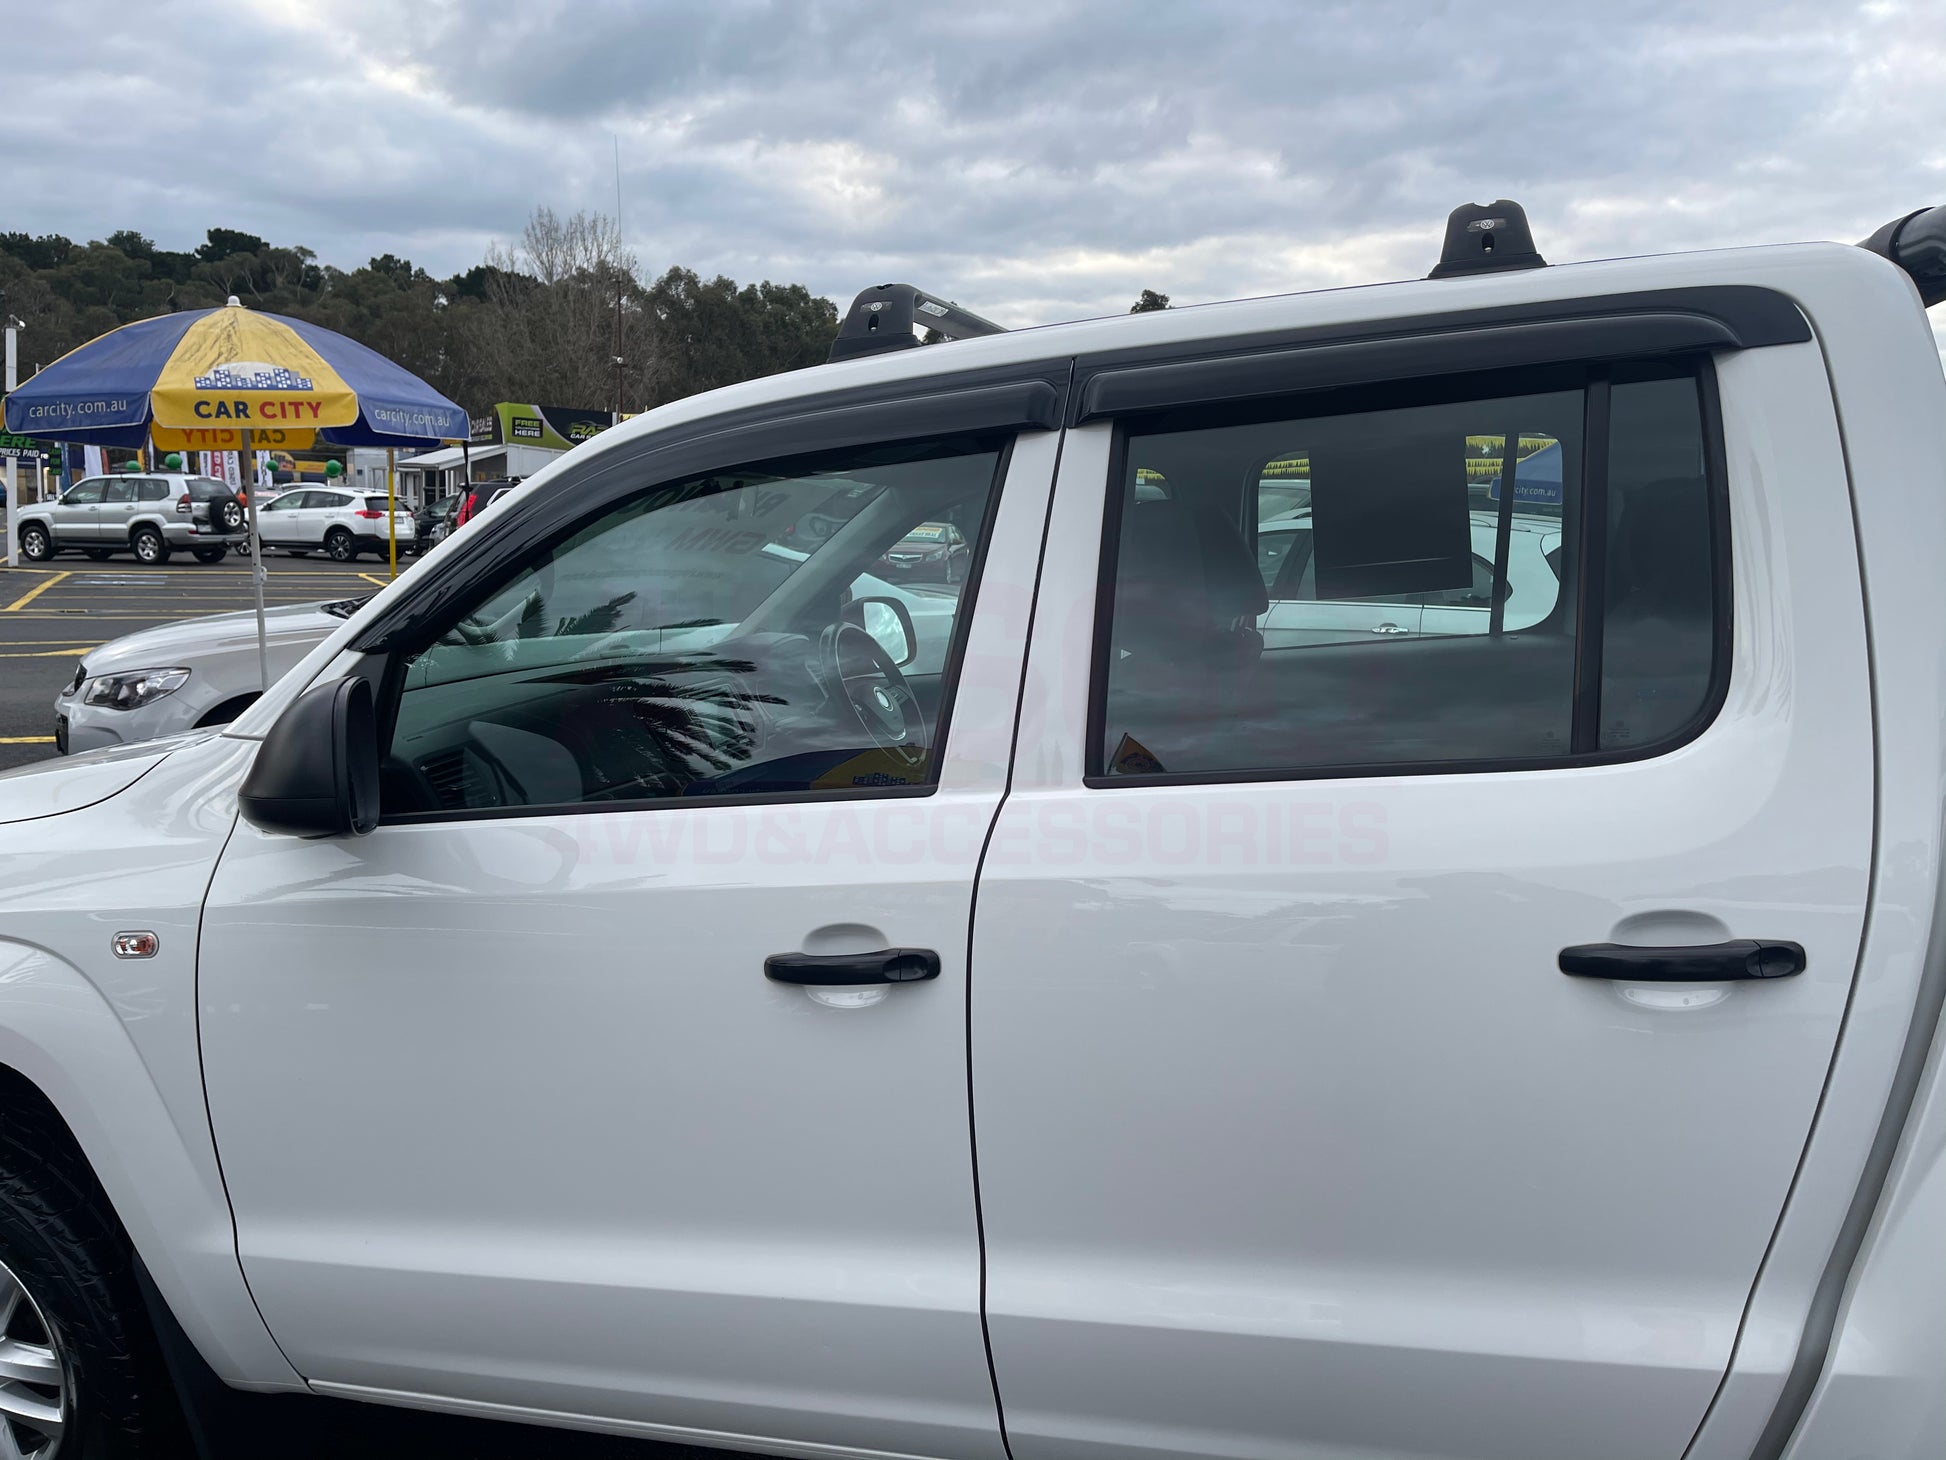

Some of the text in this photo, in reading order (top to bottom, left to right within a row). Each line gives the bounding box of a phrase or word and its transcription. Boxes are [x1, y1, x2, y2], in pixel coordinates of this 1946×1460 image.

[29, 399, 127, 417] carcity.com.au
[194, 401, 322, 418] CAR CITY
[374, 407, 450, 428] carcity.com.au
[0, 435, 37, 448] ERE
[22, 449, 40, 458] PAID
